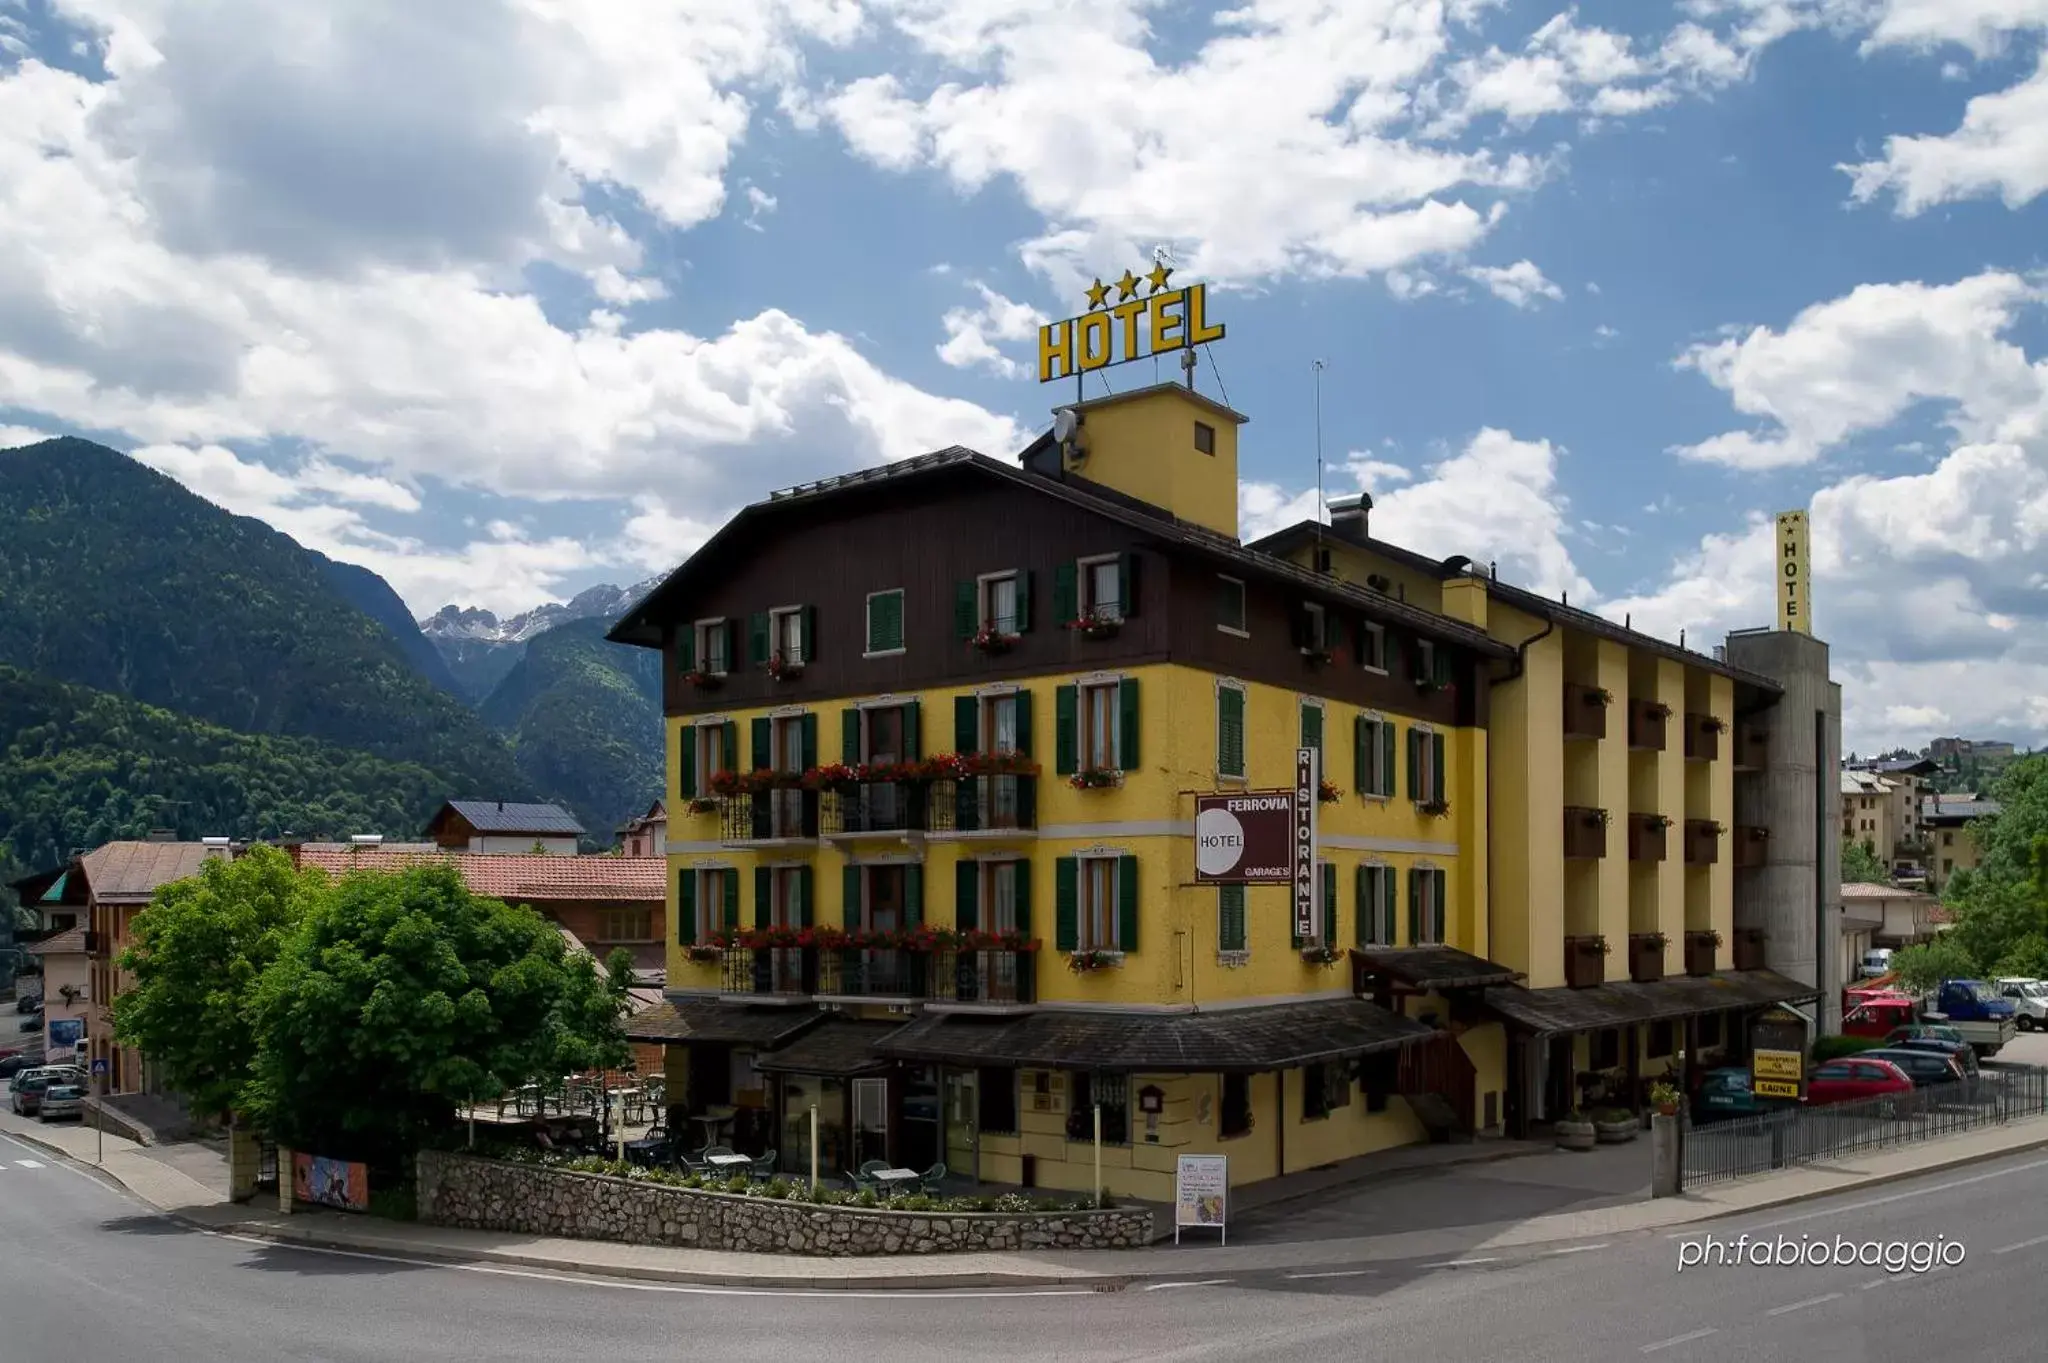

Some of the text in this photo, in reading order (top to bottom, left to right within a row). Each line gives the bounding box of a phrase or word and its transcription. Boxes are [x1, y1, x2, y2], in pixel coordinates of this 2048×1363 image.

[1039, 284, 1226, 383] HOTEL
[1227, 797, 1289, 812] FERROVIA
[1200, 835, 1243, 848] HOTEL
[1298, 750, 1310, 935] RISTORANTE
[1244, 866, 1290, 877] GARAGES
